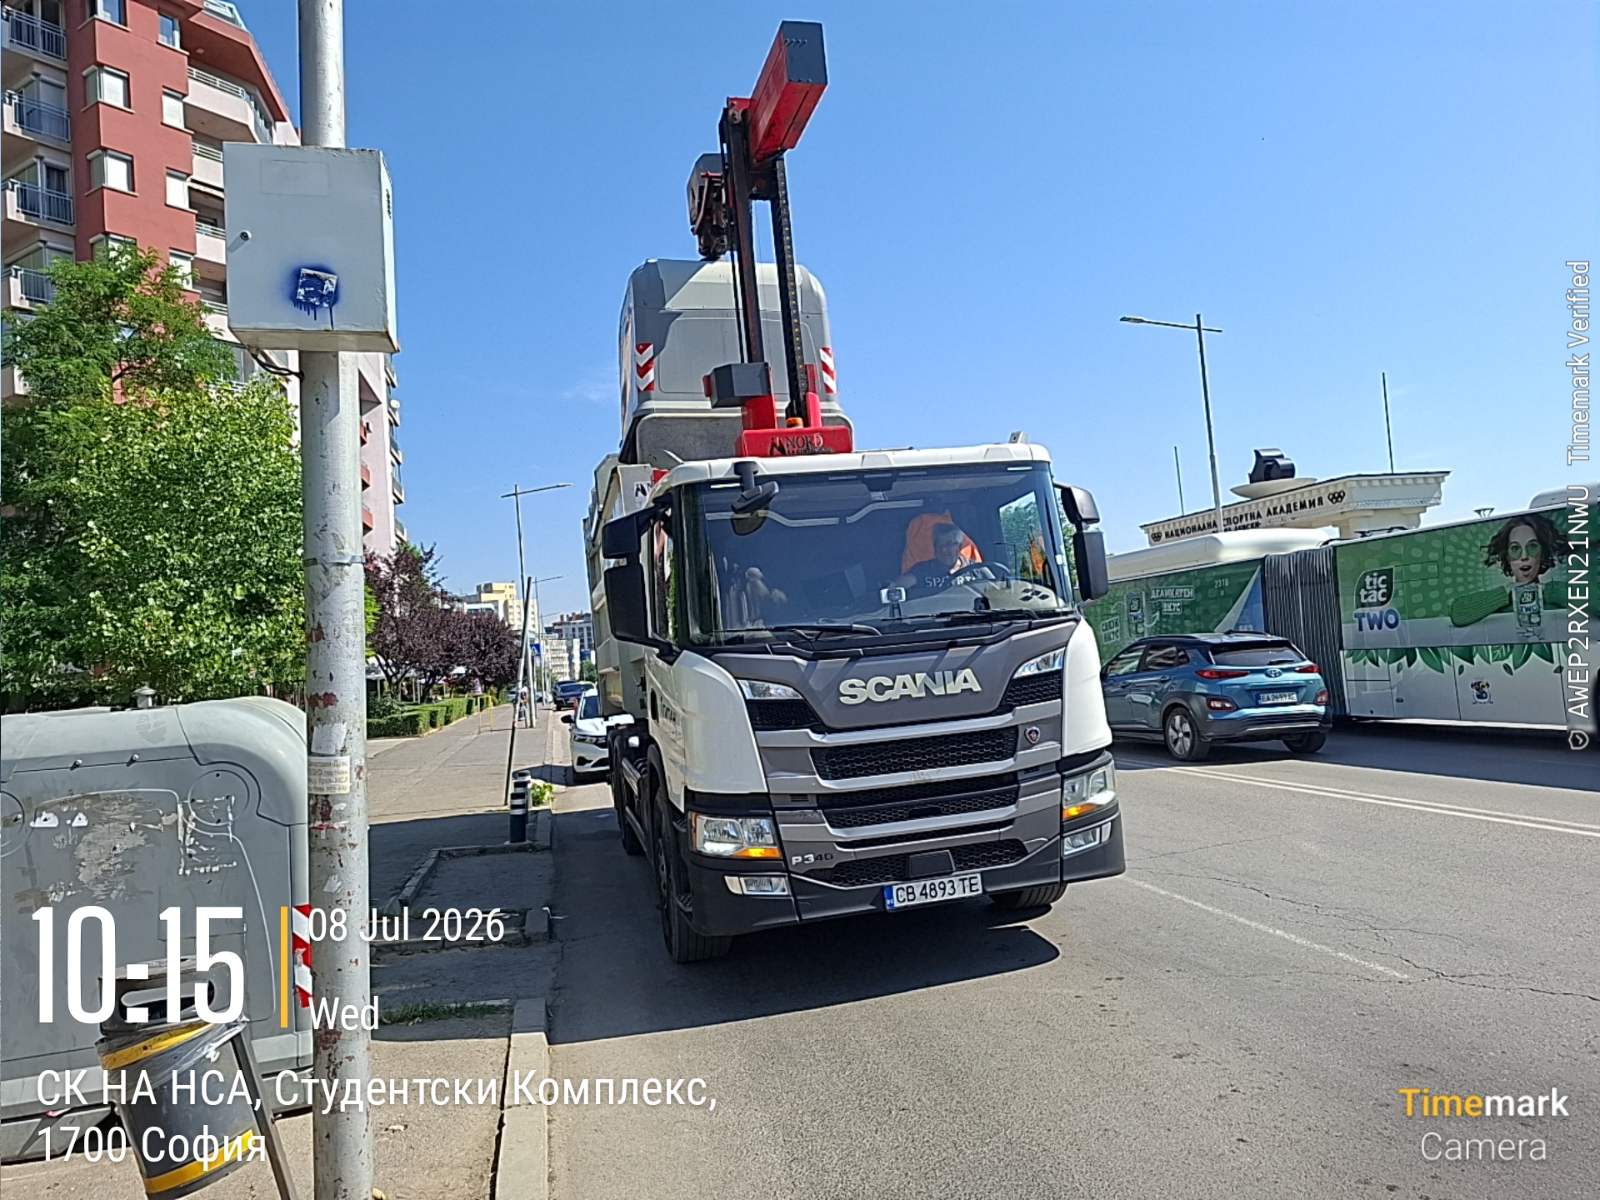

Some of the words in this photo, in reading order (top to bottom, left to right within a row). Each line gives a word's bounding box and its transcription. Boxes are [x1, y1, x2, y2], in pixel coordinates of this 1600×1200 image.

[1266, 495, 1324, 517] АКАДЕМИЯ
[1365, 572, 1387, 589] tic
[1360, 588, 1387, 602] tac
[1353, 608, 1400, 632] TWO
[839, 667, 982, 705] SCANIA
[895, 885, 916, 904] CB
[919, 879, 957, 901] 4893
[958, 875, 980, 895] TE
